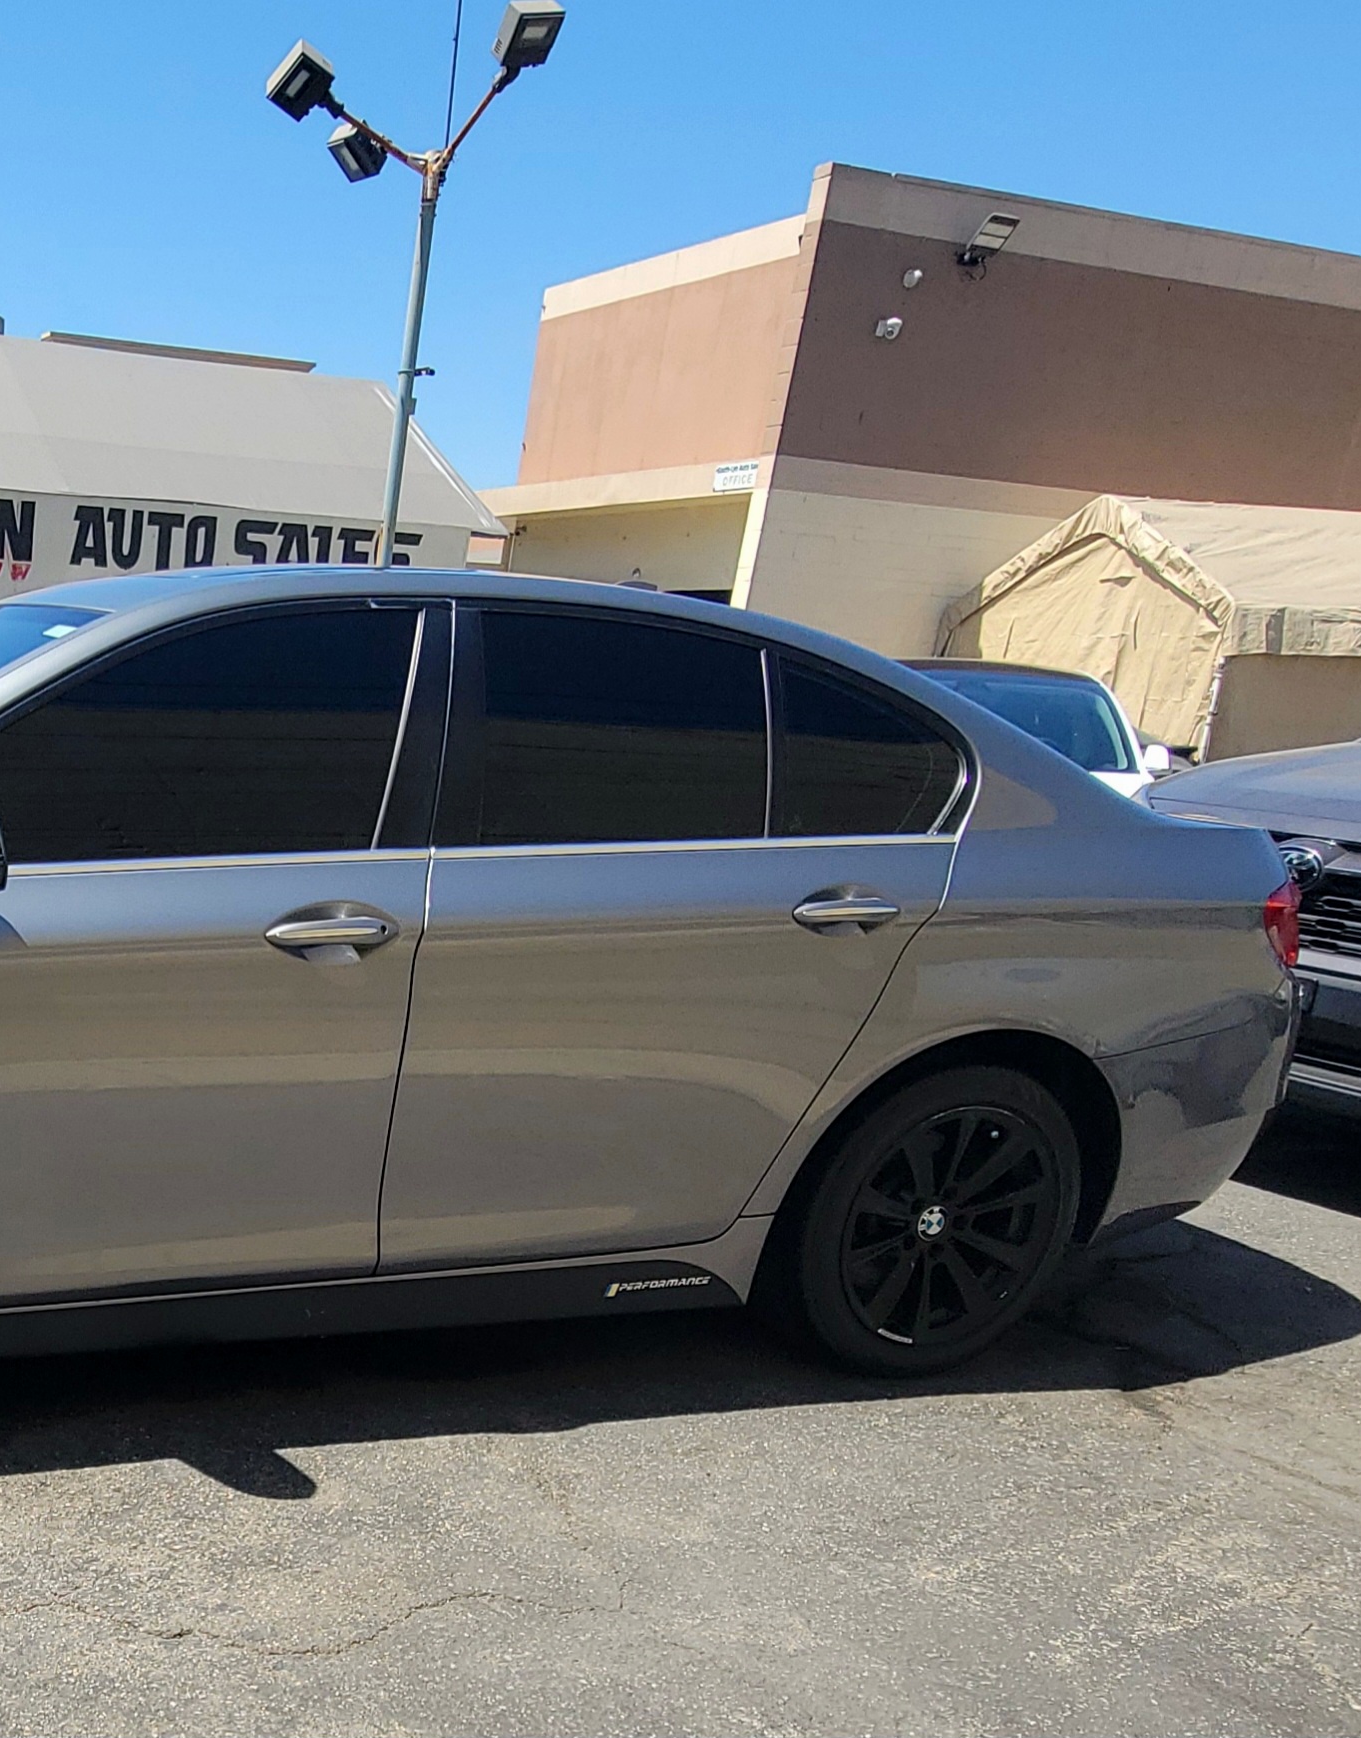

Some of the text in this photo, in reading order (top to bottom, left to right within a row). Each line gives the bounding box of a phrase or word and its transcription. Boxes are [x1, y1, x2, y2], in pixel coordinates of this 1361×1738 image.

[722, 474, 754, 486] OFFICE
[69, 505, 217, 571] AUTO
[619, 1276, 711, 1292] PERFORMANCE
